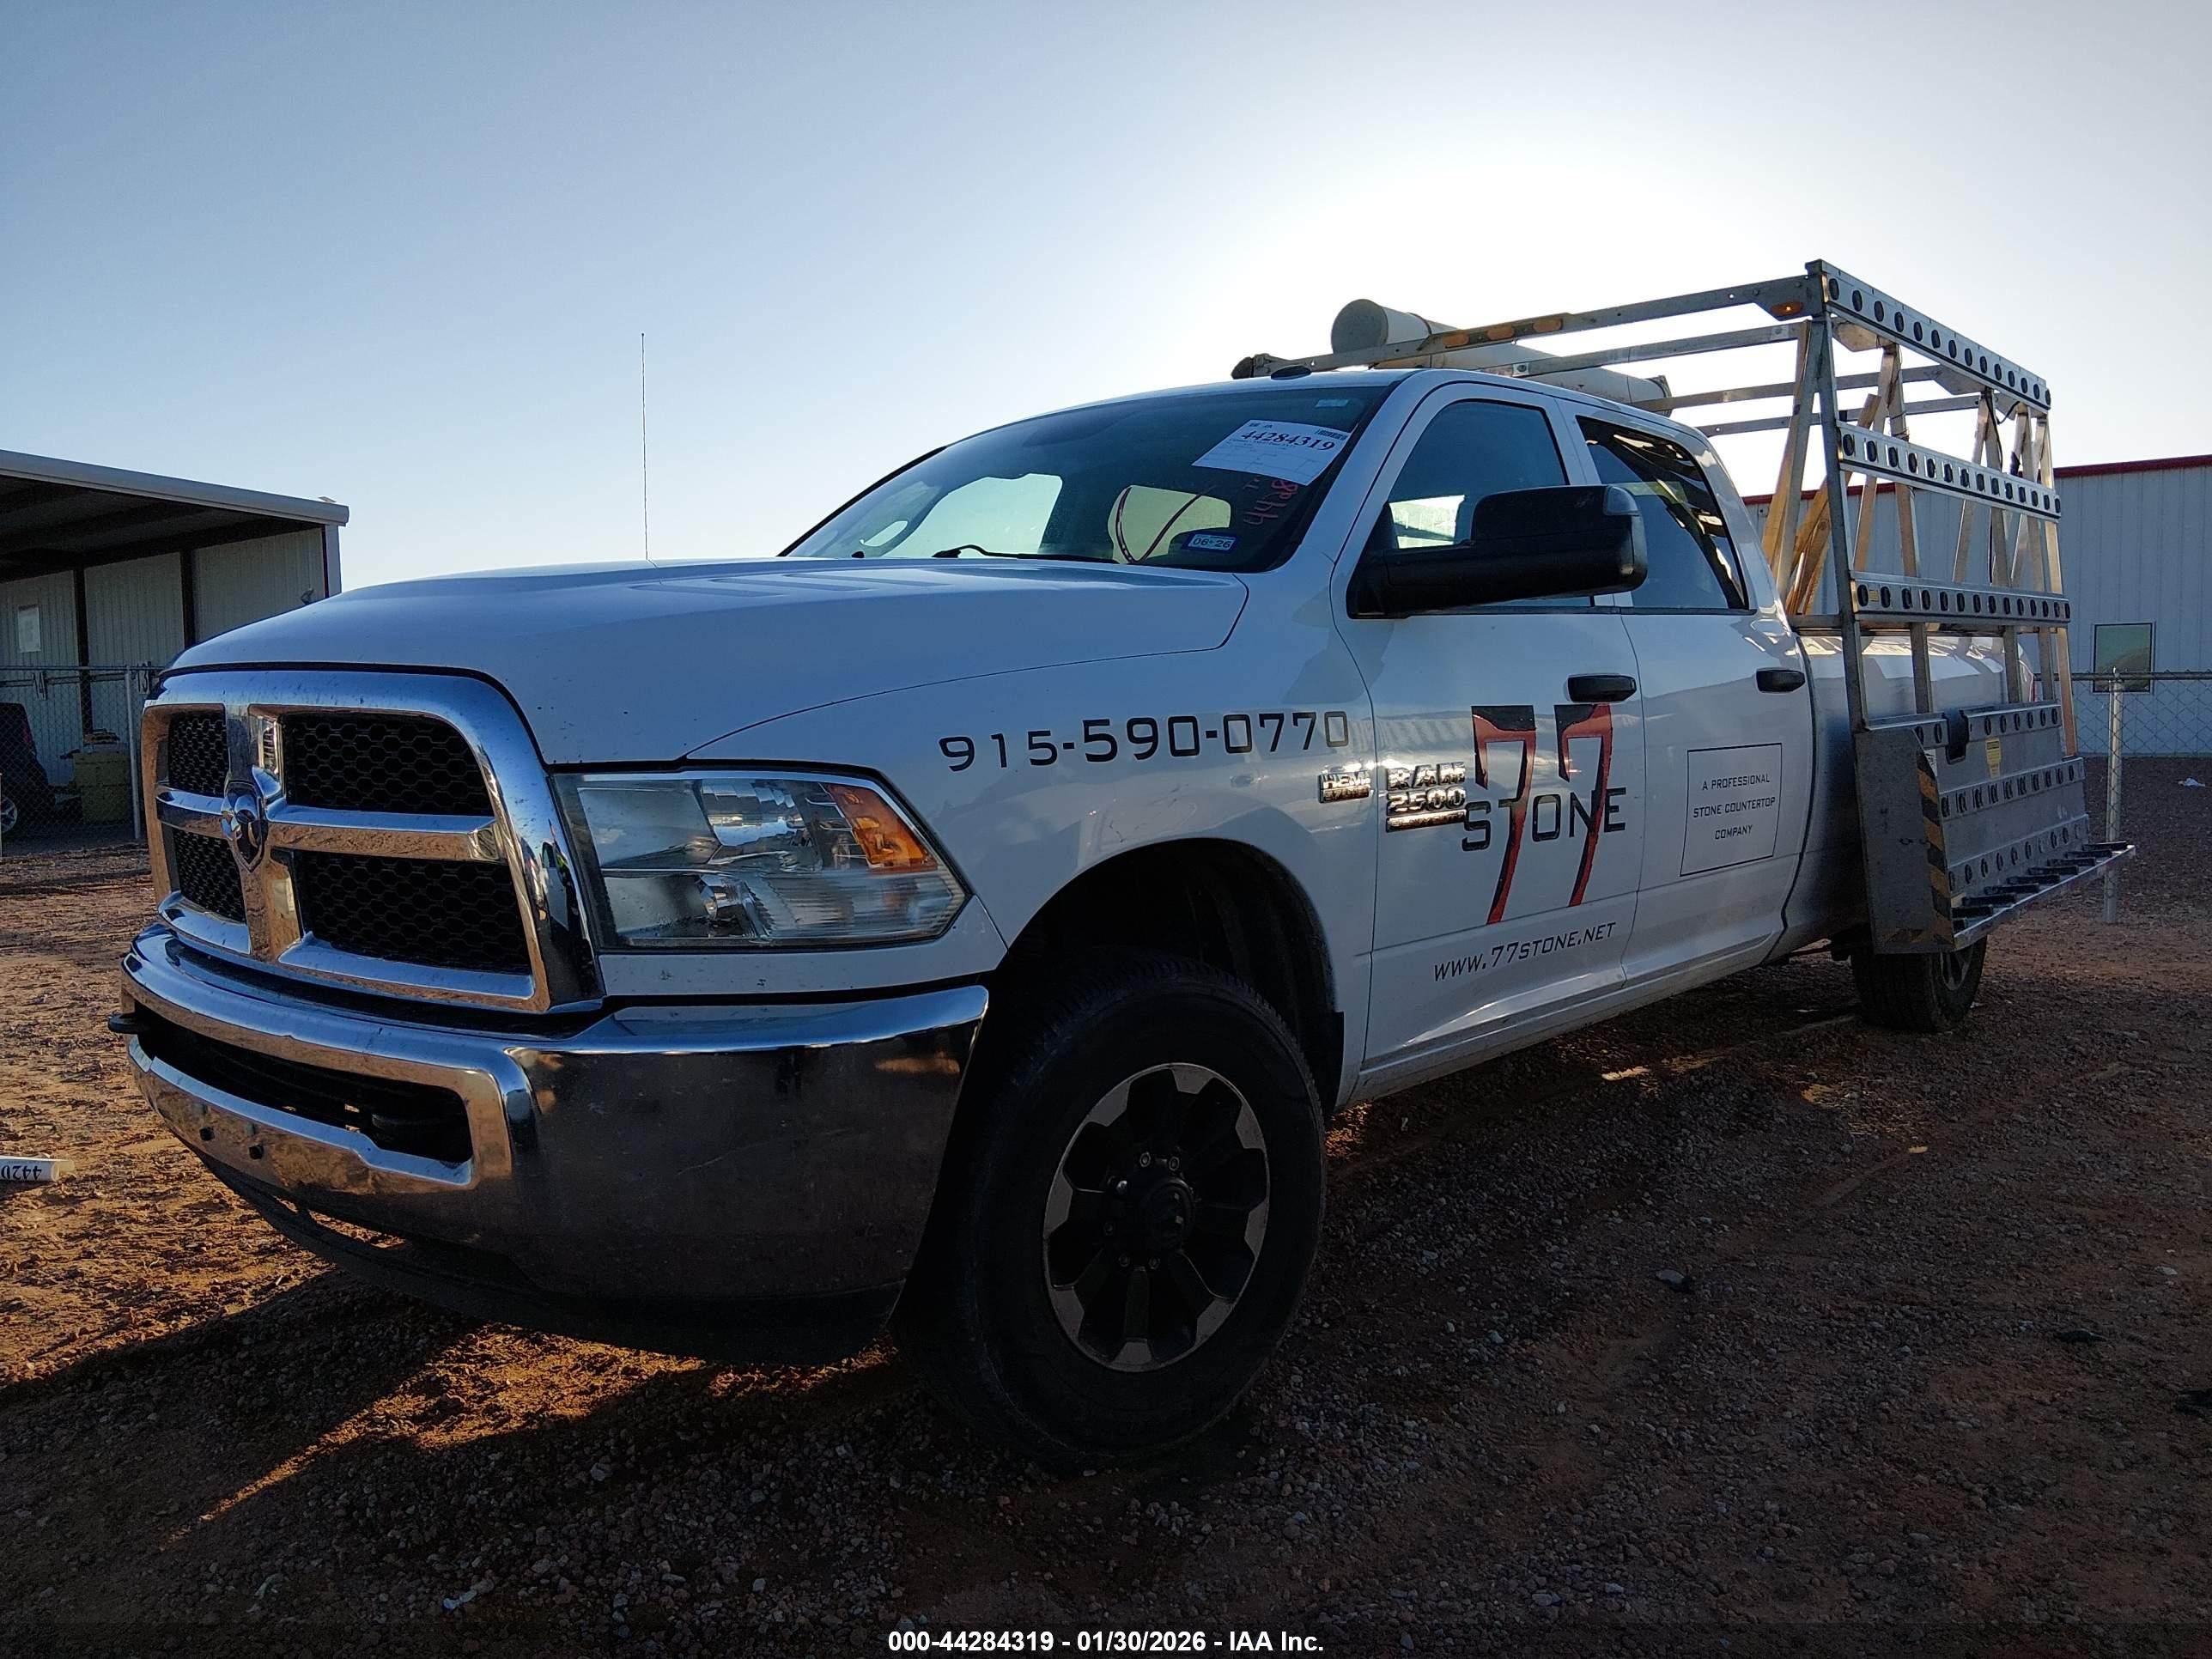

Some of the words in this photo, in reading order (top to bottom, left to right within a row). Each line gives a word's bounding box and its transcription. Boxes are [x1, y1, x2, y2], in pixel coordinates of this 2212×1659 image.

[1241, 429, 1336, 451] 44284319
[1192, 538, 1209, 546] 06
[1214, 539, 1231, 549] 26
[939, 710, 1350, 772] 915-590-0770
[1702, 780, 1709, 791] A
[1711, 773, 1771, 790] PROFESSIONAL
[1386, 785, 1467, 814] 2500
[1692, 804, 1723, 818] STONE
[1724, 796, 1777, 814] COUNTERTOP
[1462, 787, 1627, 852] STONE
[1471, 703, 1613, 925] 77
[1714, 824, 1753, 840] COMPANY
[1434, 921, 1617, 982] WWW.77STONE.NET
